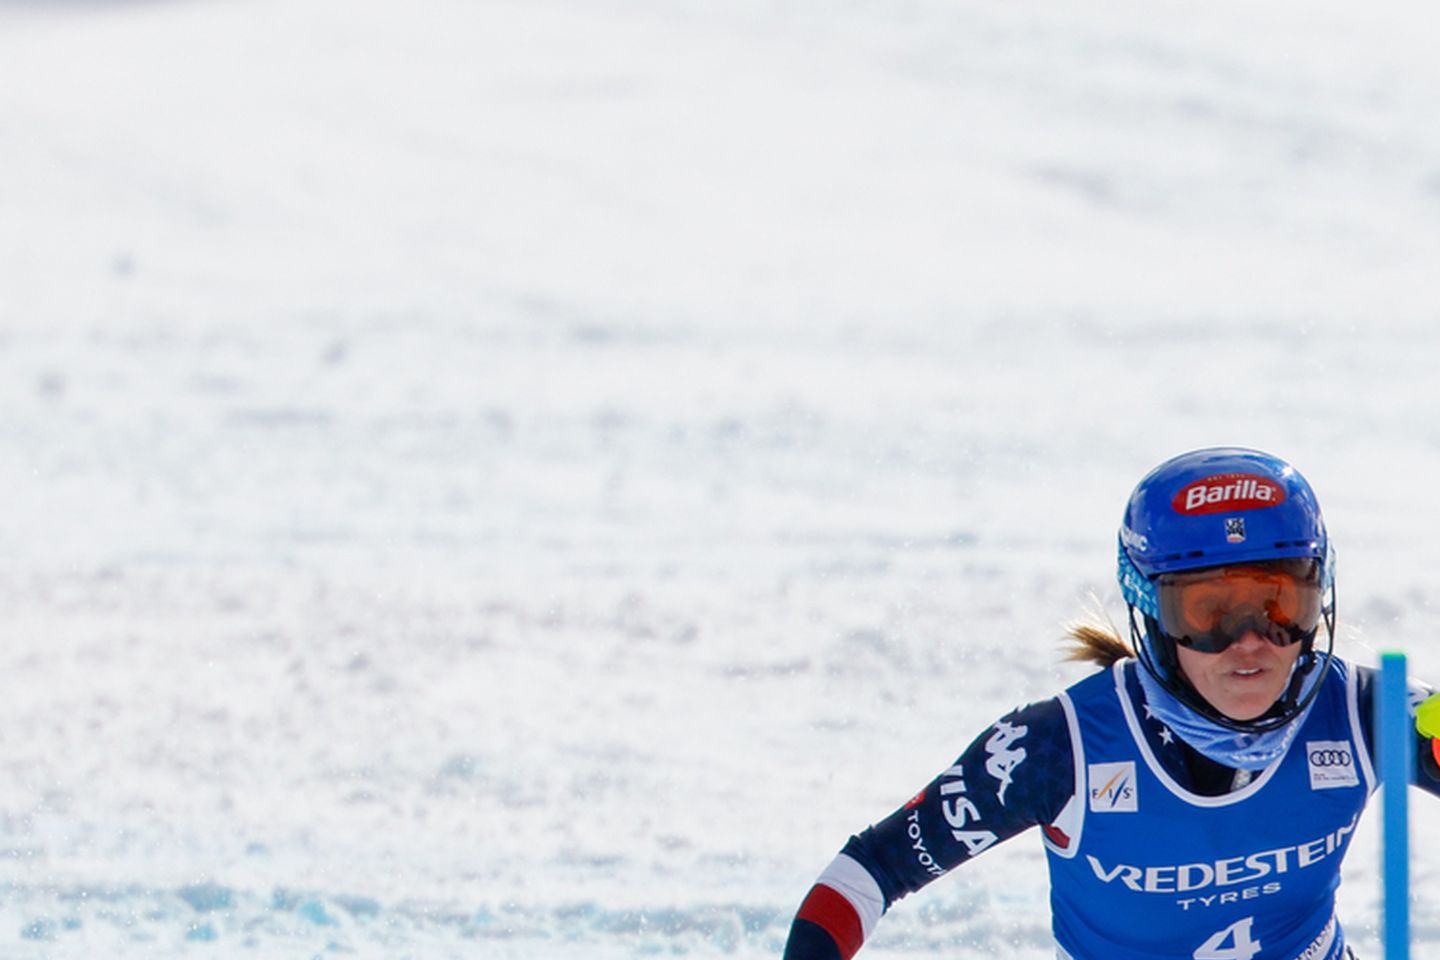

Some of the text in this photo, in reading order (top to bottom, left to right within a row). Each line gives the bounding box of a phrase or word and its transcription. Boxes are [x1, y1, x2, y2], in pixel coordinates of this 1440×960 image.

[1185, 479, 1276, 510] Barilla
[1086, 814, 1358, 892] VREDESTEIN
[1177, 882, 1282, 910] TYRES
